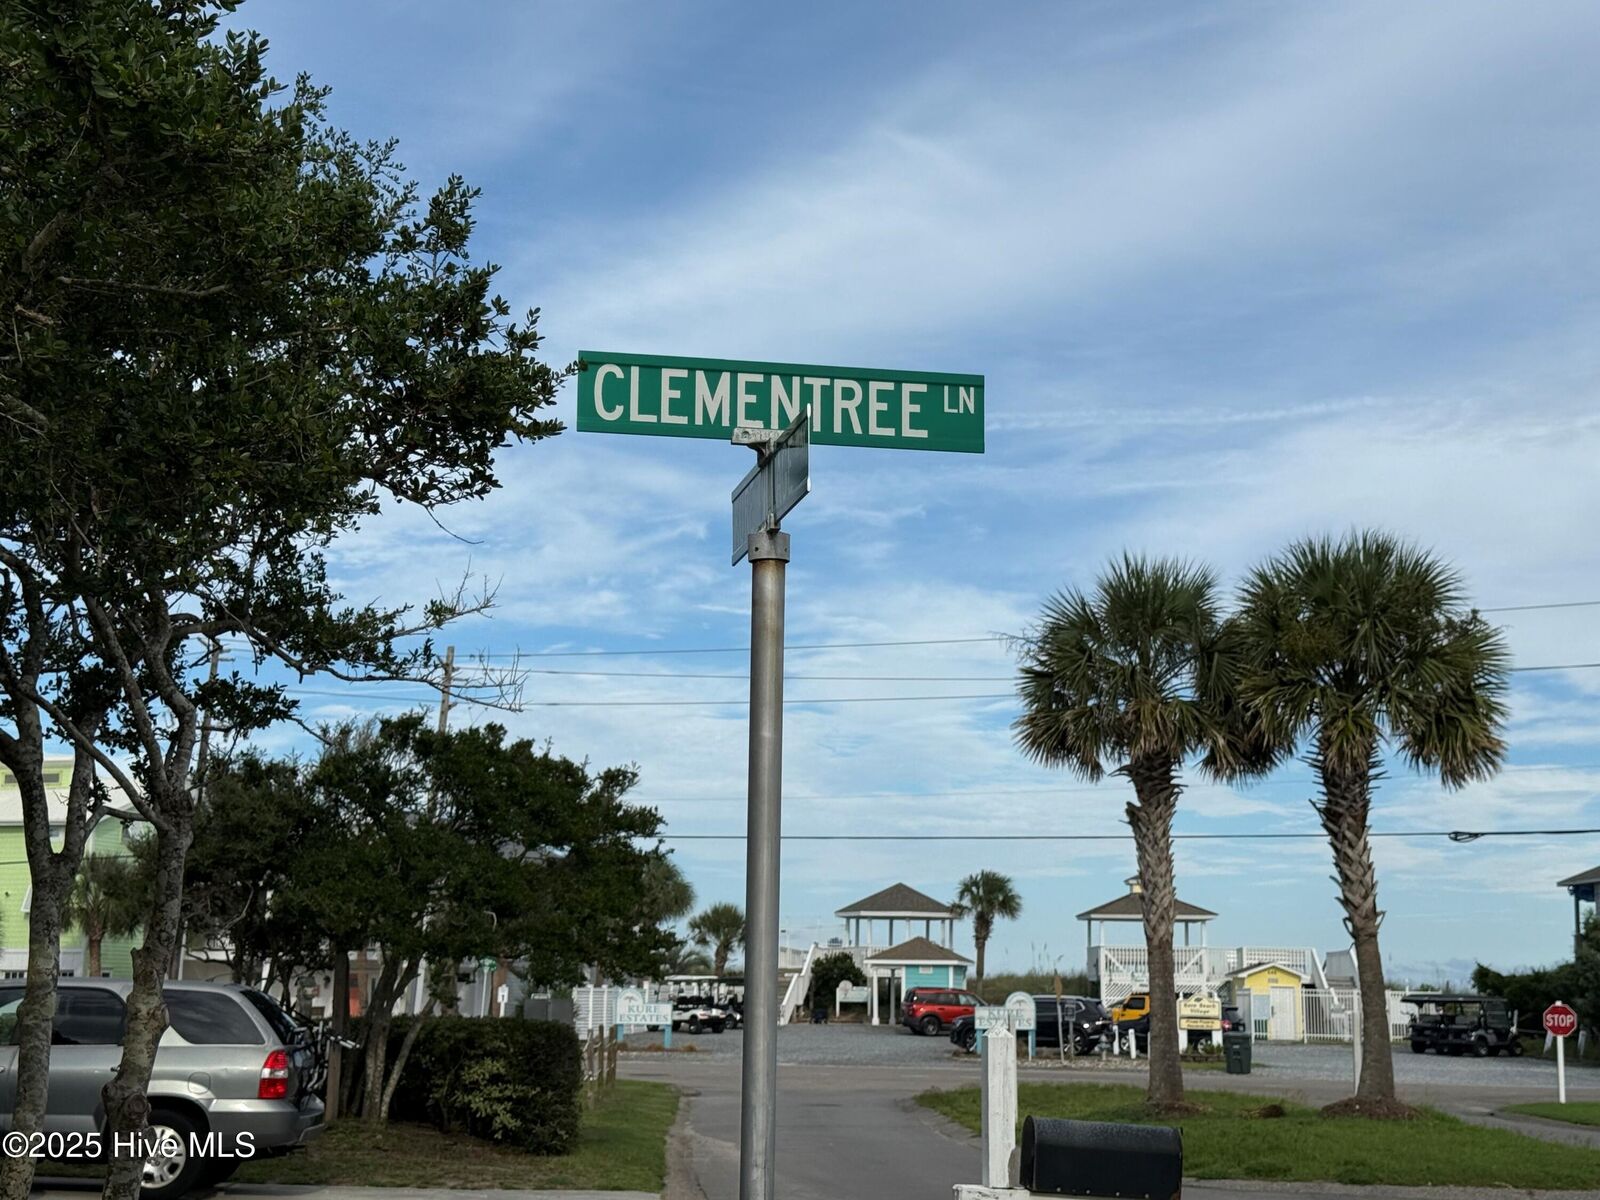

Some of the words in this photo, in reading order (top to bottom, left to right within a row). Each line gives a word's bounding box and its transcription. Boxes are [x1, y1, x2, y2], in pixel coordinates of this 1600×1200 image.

[593, 363, 929, 438] CLEMENTREE
[943, 385, 975, 415] LN
[619, 1014, 669, 1022] ESTATES
[1546, 1013, 1574, 1027] STOP
